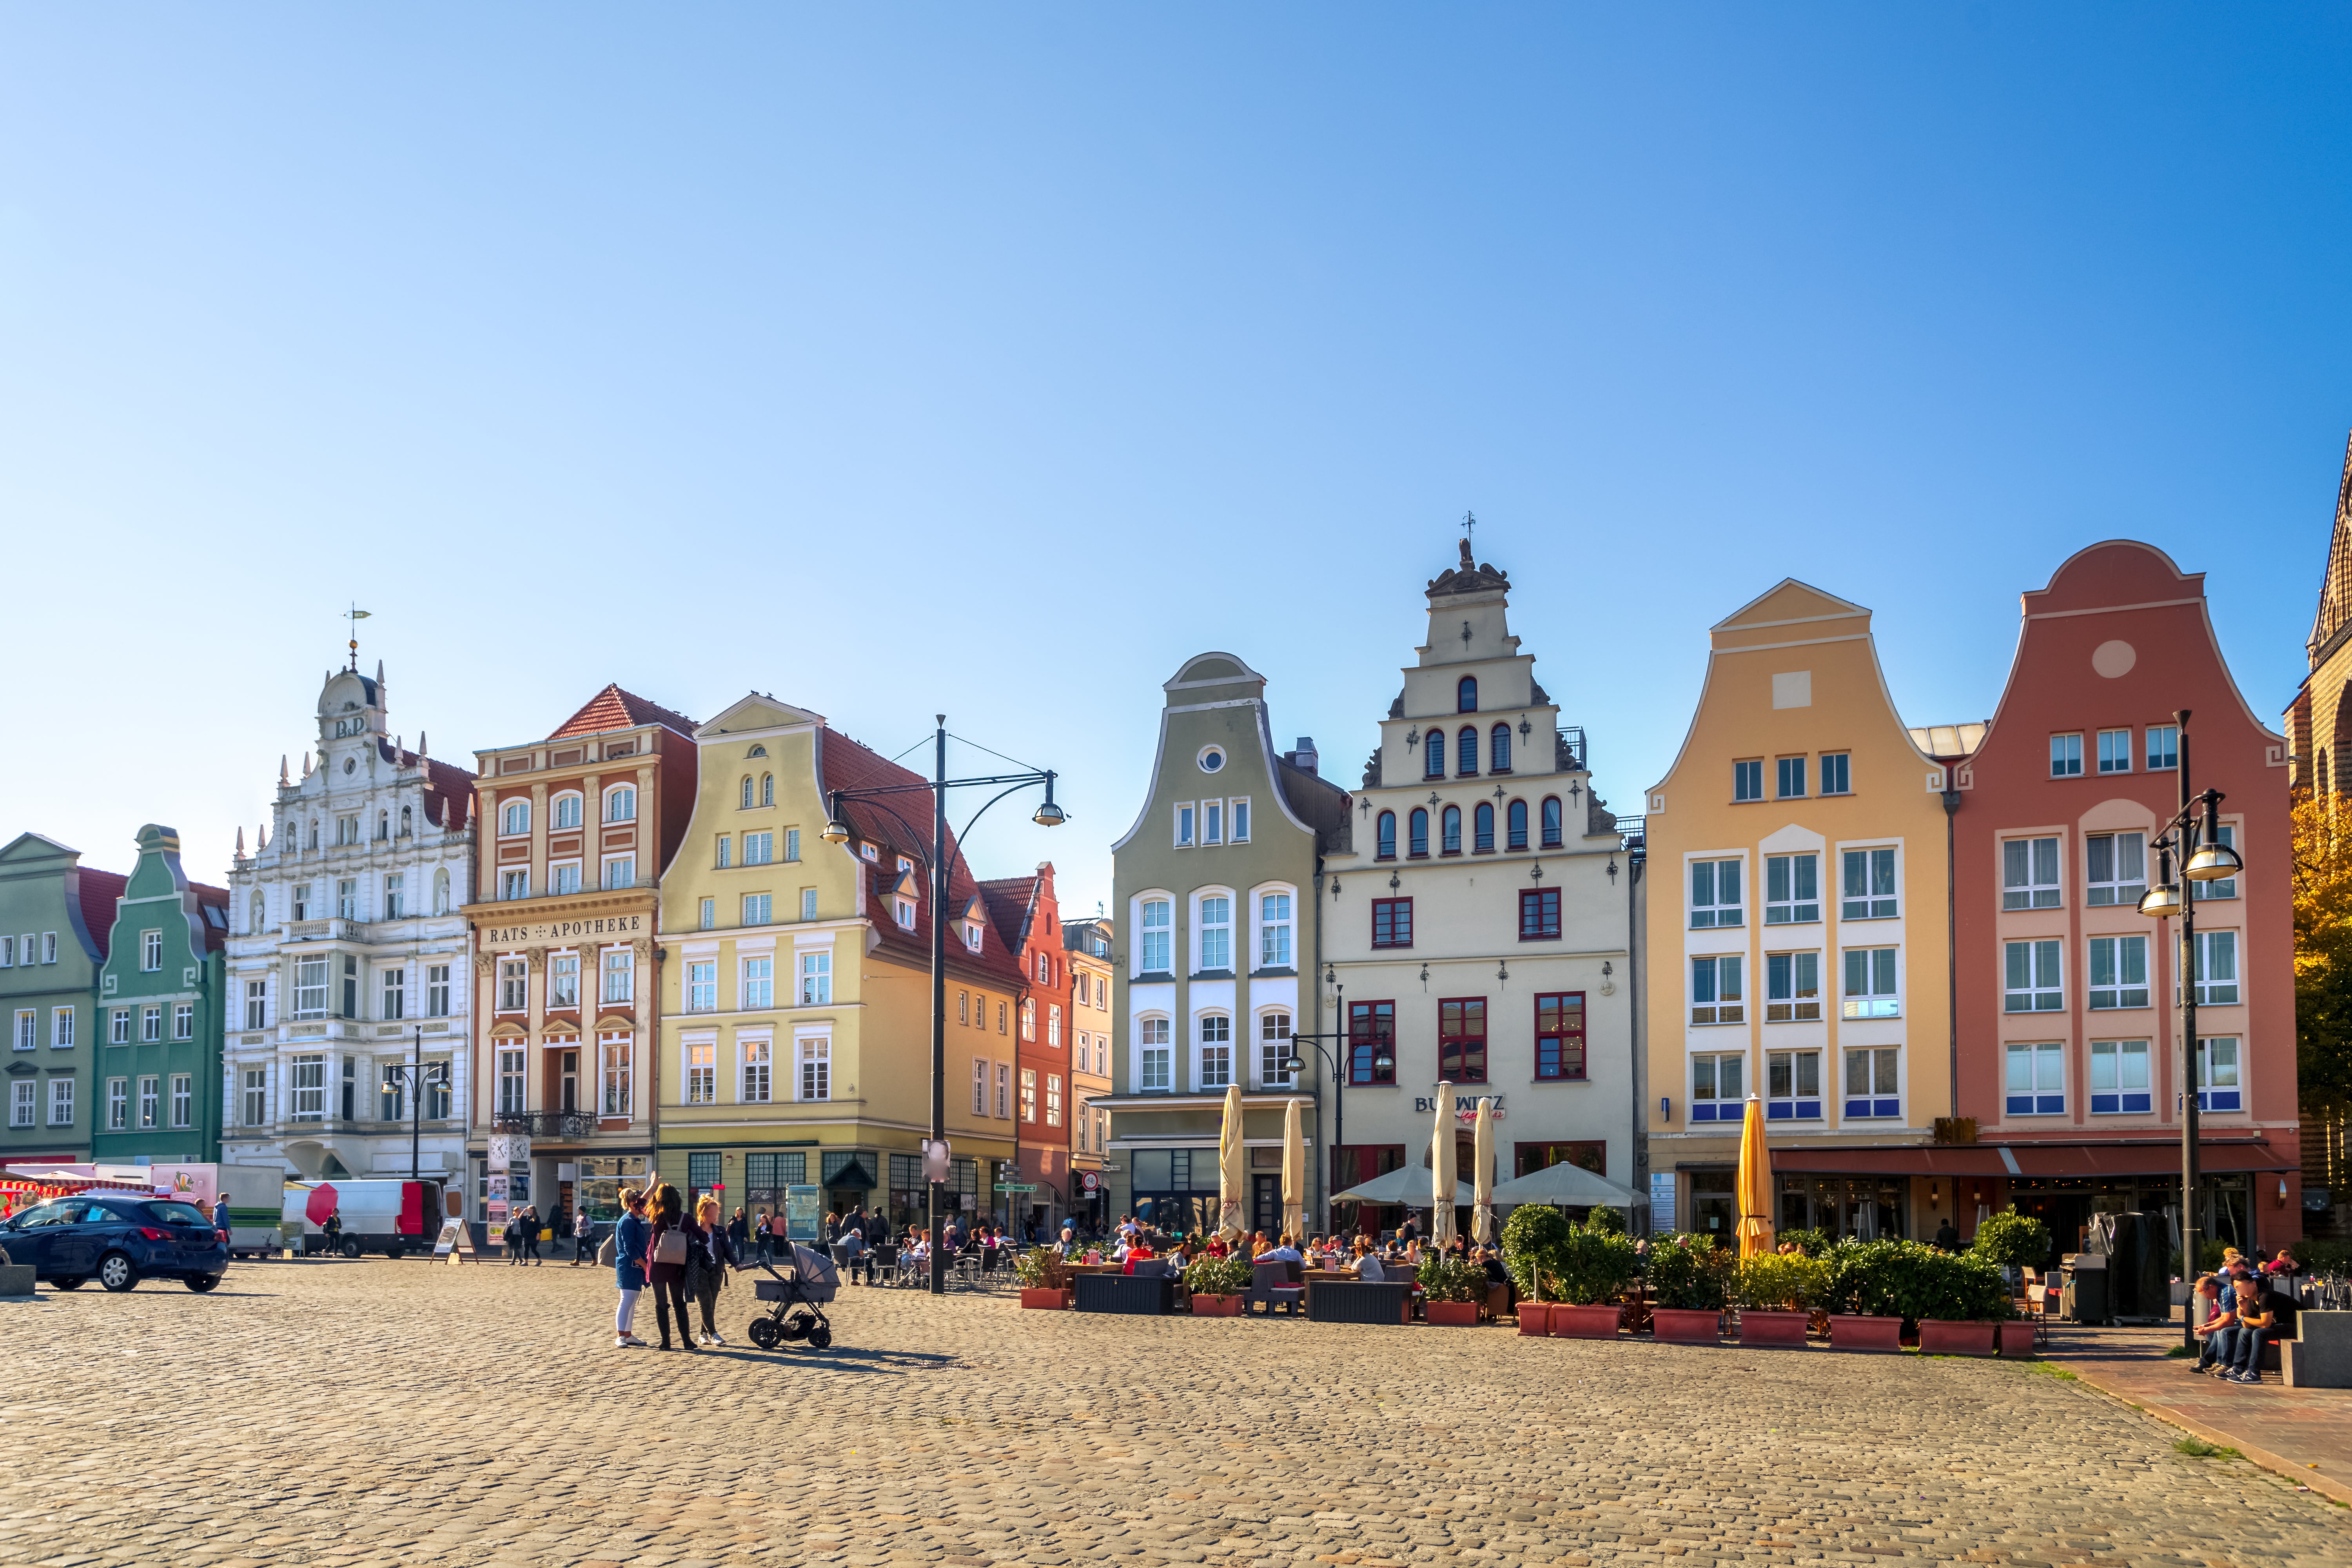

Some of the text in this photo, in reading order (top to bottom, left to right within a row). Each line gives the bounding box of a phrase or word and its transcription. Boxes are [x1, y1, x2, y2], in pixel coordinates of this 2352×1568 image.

[490, 916, 639, 942] RATS APOTHEKE
[1415, 1096, 1504, 1111] BUWIZ
